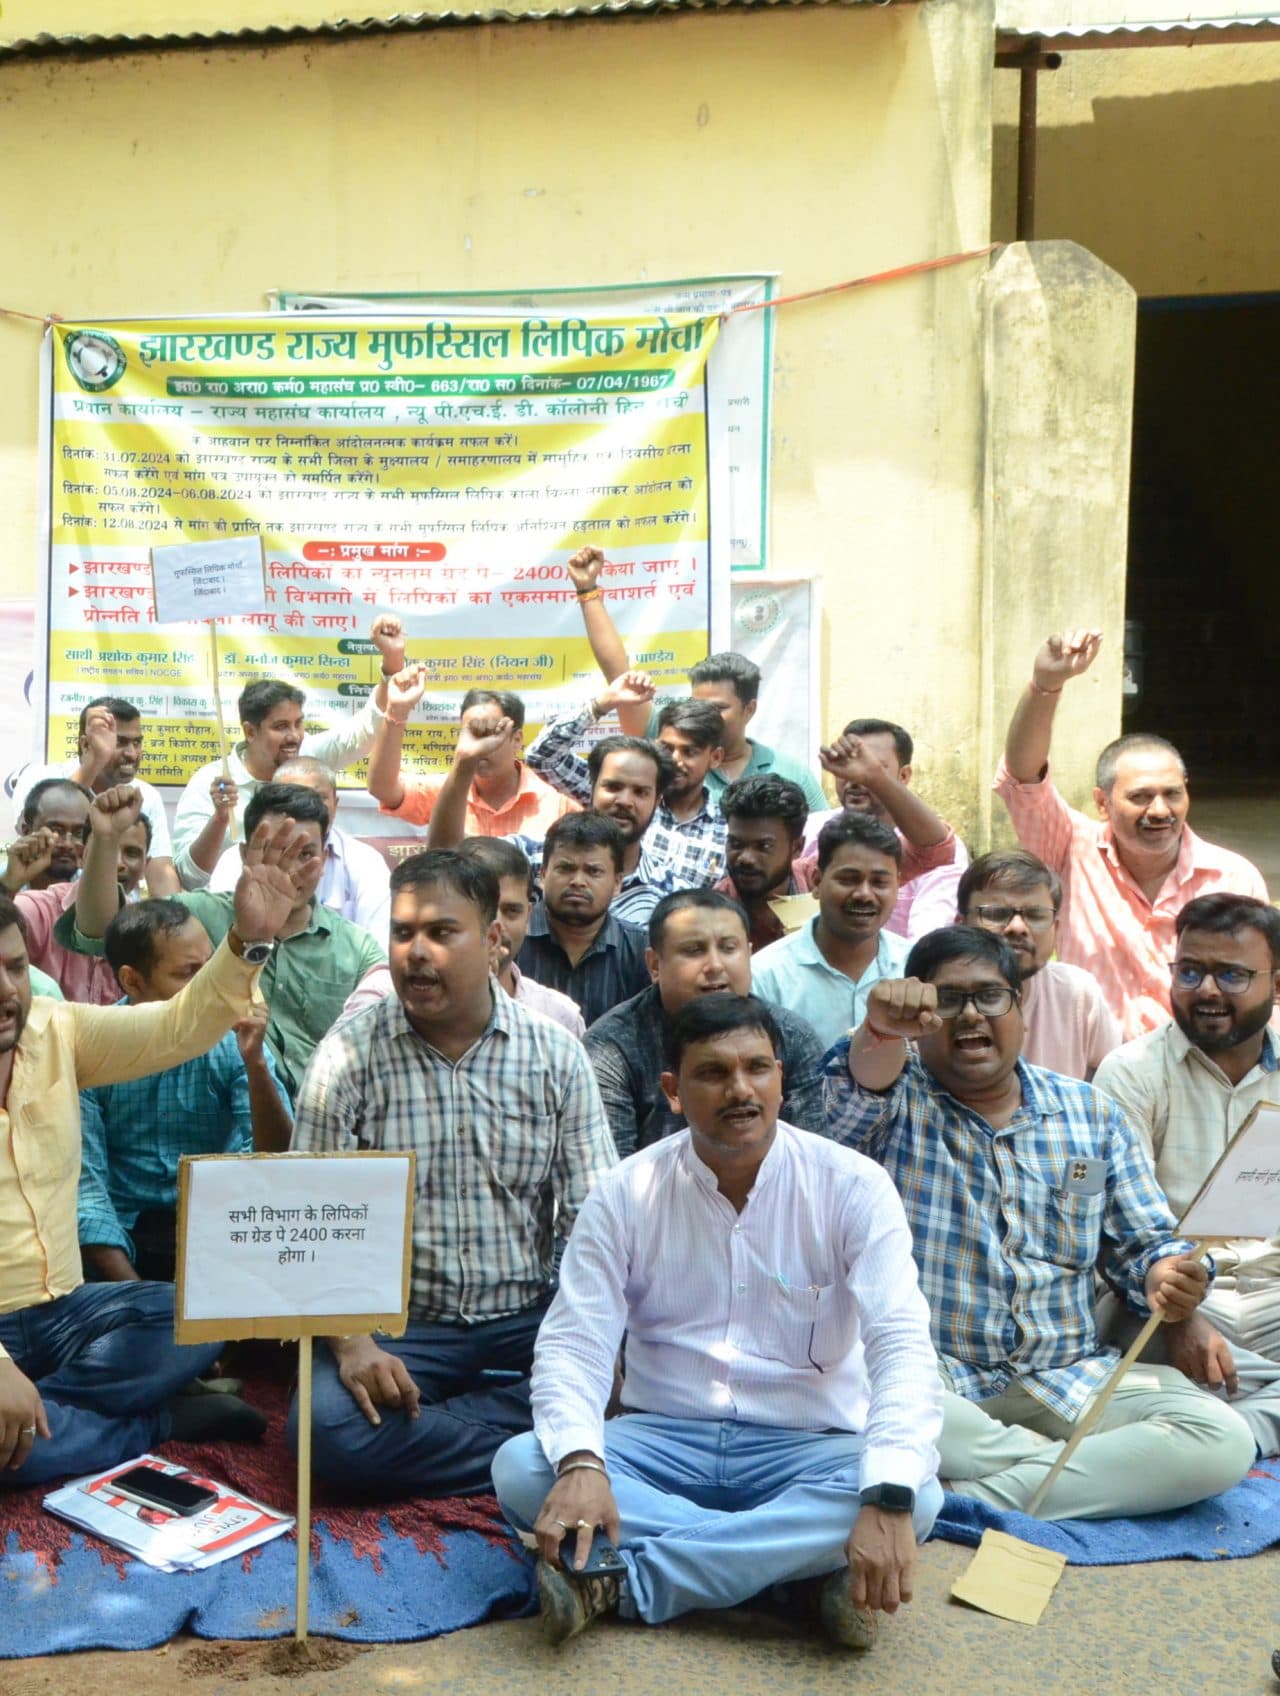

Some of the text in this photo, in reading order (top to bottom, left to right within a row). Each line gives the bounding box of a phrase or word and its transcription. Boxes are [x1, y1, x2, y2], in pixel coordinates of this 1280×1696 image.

[139, 331, 276, 367] झारखण्ड
[287, 330, 358, 361] राज्य
[368, 320, 511, 370] मुफस्सिल
[520, 317, 625, 358] लिपिक
[309, 374, 668, 394] महासंघ 07/04/1967
[211, 405, 248, 419] राज्य
[254, 403, 310, 421] महासंघ
[318, 401, 386, 420] कार्यालय
[255, 437, 272, 448] पर
[459, 437, 489, 447] सफल
[175, 450, 190, 464] को
[282, 452, 293, 465] के
[298, 452, 322, 466] सभी
[328, 452, 358, 466] जिला
[363, 453, 373, 466] के
[183, 469, 205, 482] मांग
[188, 519, 208, 532] मांग
[340, 543, 409, 561] प्रमुख मांग
[83, 561, 152, 576] झारखण्ड
[468, 591, 492, 605] का
[668, 580, 696, 601] एवं
[283, 610, 305, 628] की
[136, 651, 168, 666] कुमार
[282, 655, 314, 669] कुमार
[228, 1203, 369, 1224] सभी विभाग के लिपिकों
[230, 1225, 365, 1244] का ग्रेड पे 2400 करना
[278, 1246, 306, 1265] होगा
